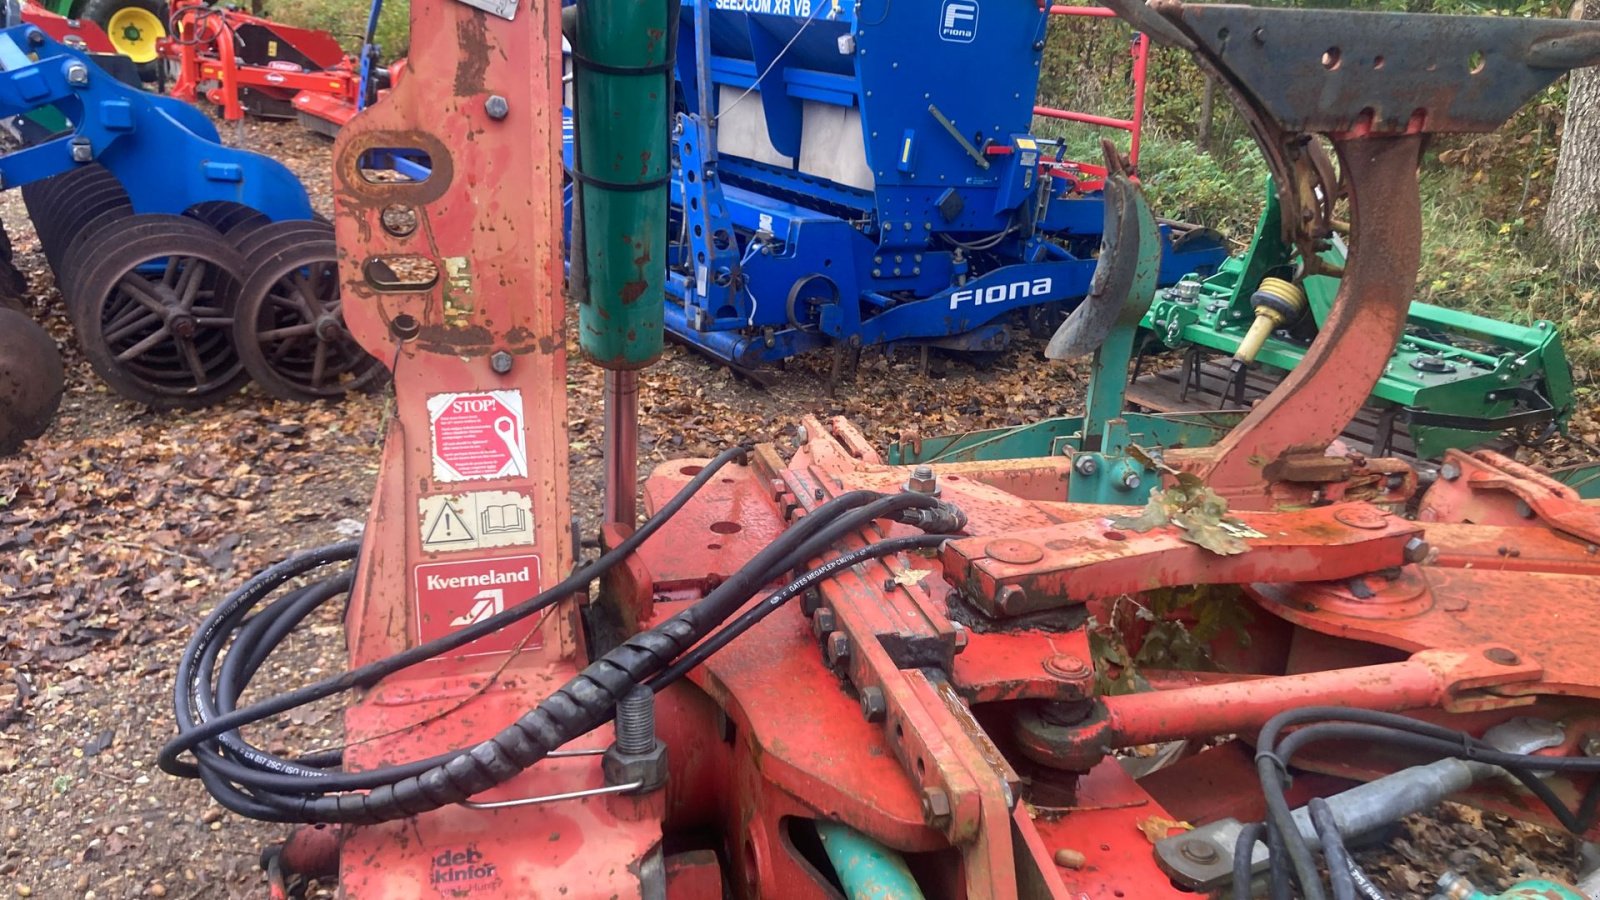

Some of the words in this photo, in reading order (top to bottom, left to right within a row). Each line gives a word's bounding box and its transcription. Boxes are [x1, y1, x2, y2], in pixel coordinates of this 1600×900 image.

[715, 0, 771, 13] SEEDCOM
[773, 0, 791, 15] XR
[794, 0, 811, 17] VB
[452, 399, 497, 414] STOP!
[427, 566, 529, 591] Kverneland
[789, 578, 808, 592] GATES
[266, 760, 281, 771] 2SC
